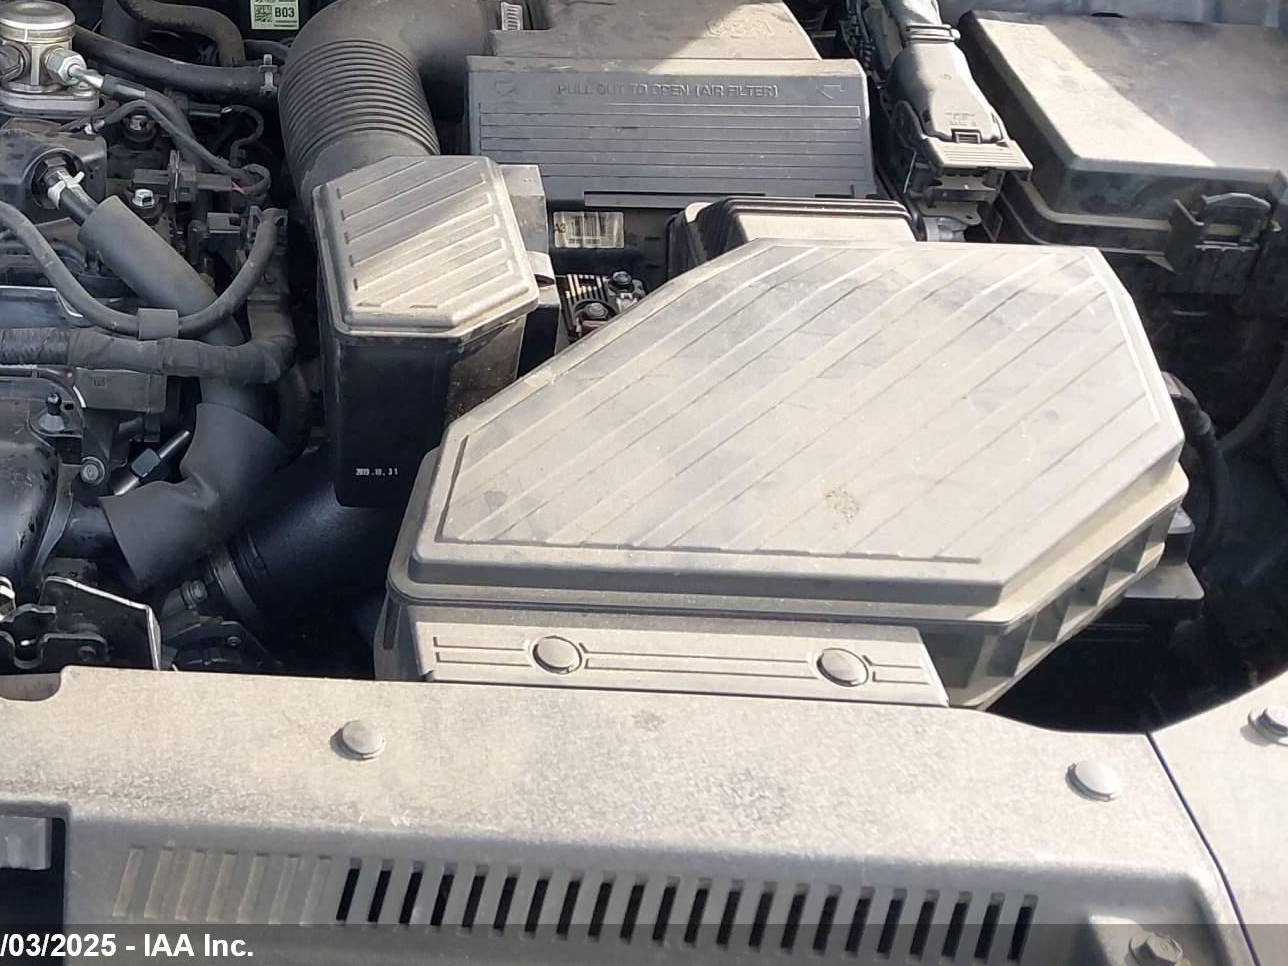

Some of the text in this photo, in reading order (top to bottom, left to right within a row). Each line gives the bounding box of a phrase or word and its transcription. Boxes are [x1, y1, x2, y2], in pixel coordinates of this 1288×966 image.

[274, 6, 295, 18] B03
[558, 82, 593, 95] PULL
[632, 83, 648, 95] TO
[652, 83, 689, 96] OPEN
[727, 85, 779, 98] FILTER)
